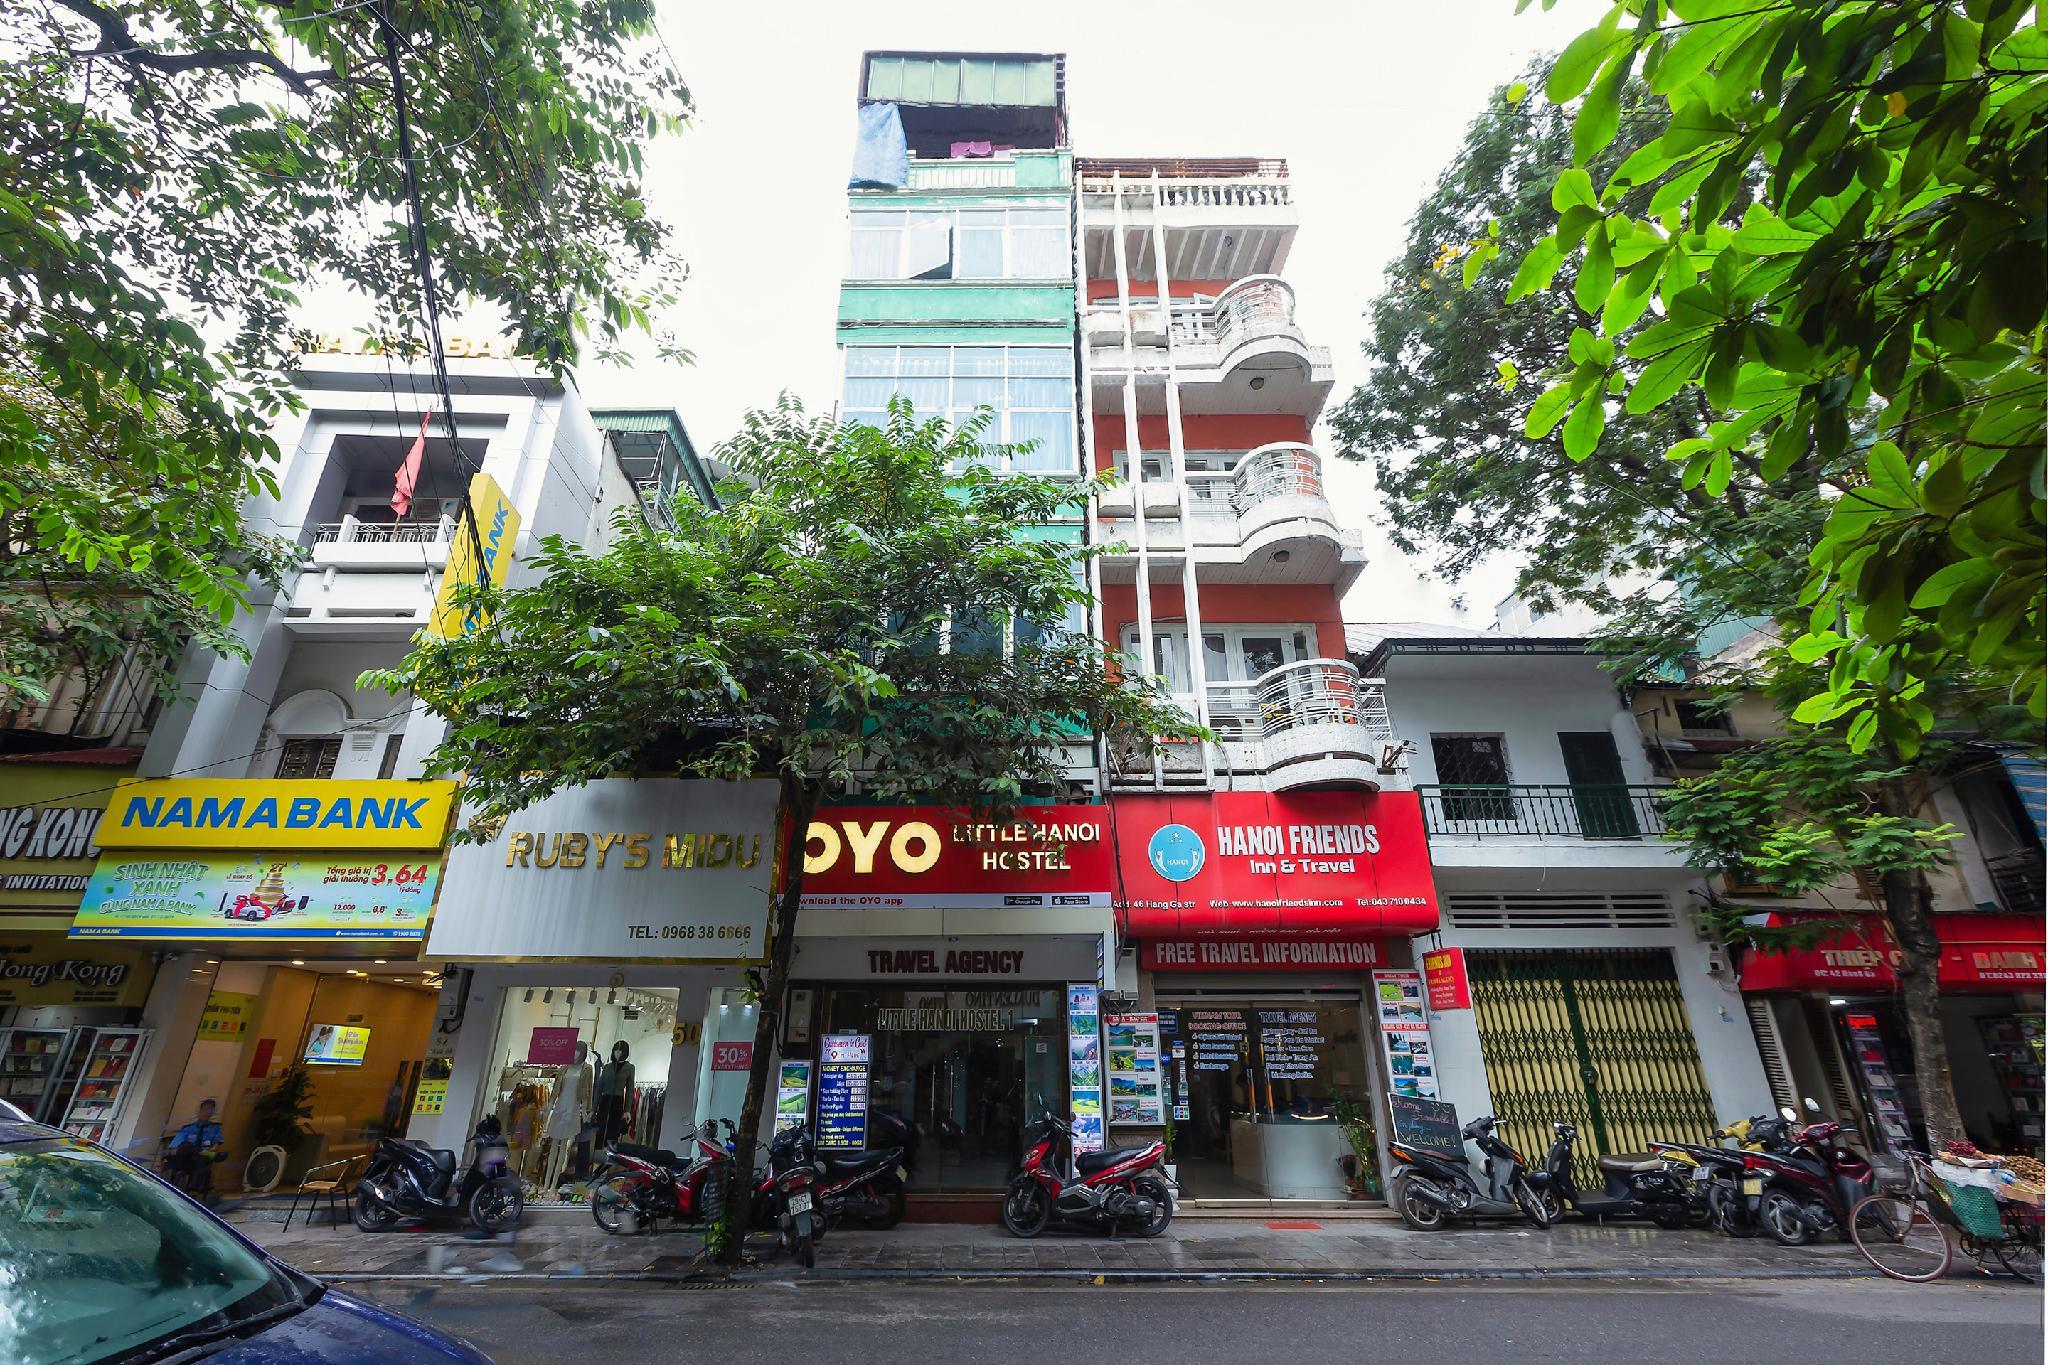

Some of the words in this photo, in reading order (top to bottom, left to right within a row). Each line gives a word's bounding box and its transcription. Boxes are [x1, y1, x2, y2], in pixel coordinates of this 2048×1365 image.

[802, 821, 941, 873] OYO
[953, 824, 1026, 842] LITTLE
[1033, 823, 1100, 842] HANOI
[1217, 825, 1284, 856] HANOI
[1290, 824, 1380, 855] FRIENDS
[506, 832, 651, 869] RUBY'S
[661, 833, 761, 869] MIDU
[983, 851, 1072, 871] HOSTEL
[1250, 859, 1277, 874] Inn
[1280, 859, 1296, 874] &
[1298, 859, 1355, 874] Travel
[114, 863, 154, 882] SINH
[129, 880, 182, 898] XANH
[840, 896, 856, 905] the
[859, 896, 881, 905] OYO
[1133, 900, 1144, 908] 46
[1146, 900, 1169, 909] Hang
[1170, 900, 1182, 908] Ga
[628, 926, 659, 939] TEL:
[661, 926, 695, 939] 0968
[698, 926, 714, 938] 38
[717, 926, 752, 938] 6666
[867, 950, 940, 974] TRAVEL
[944, 950, 1024, 974] AGENCY
[1155, 943, 1196, 963] FREE
[1201, 943, 1260, 963] TRAVEL
[1263, 943, 1377, 963] INFORMATION
[878, 1009, 917, 1031] LITTLE
[918, 1009, 957, 1031] HANOI
[958, 1009, 1005, 1031] HOSTEL
[1007, 1009, 1015, 1031] 1
[1259, 1011, 1288, 1023] TRAVEL
[1288, 1011, 1317, 1023] AGENCY
